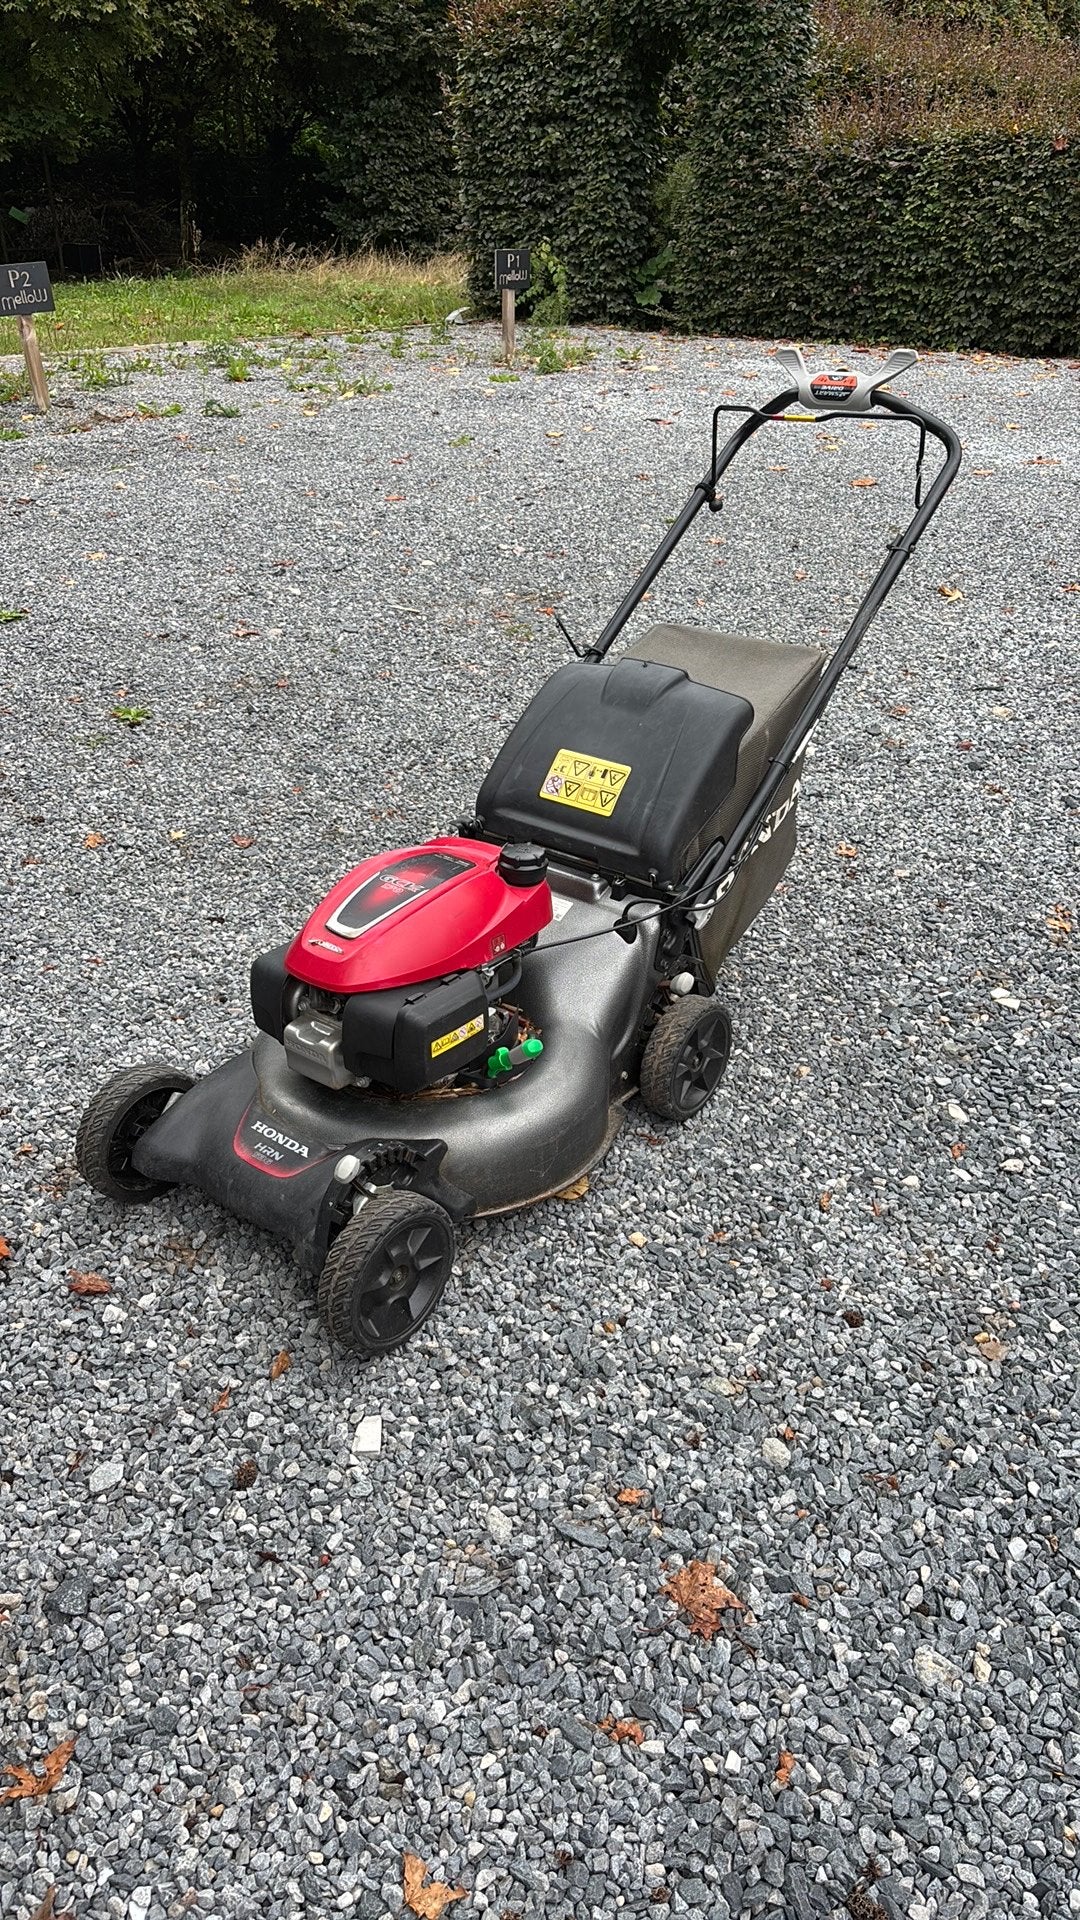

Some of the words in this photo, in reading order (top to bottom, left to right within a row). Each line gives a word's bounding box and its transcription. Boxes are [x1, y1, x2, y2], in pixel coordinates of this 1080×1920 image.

[507, 253, 520, 268] P1
[8, 269, 32, 288] P2
[251, 1121, 309, 1158] HONDA
[254, 1142, 284, 1161] HRN
